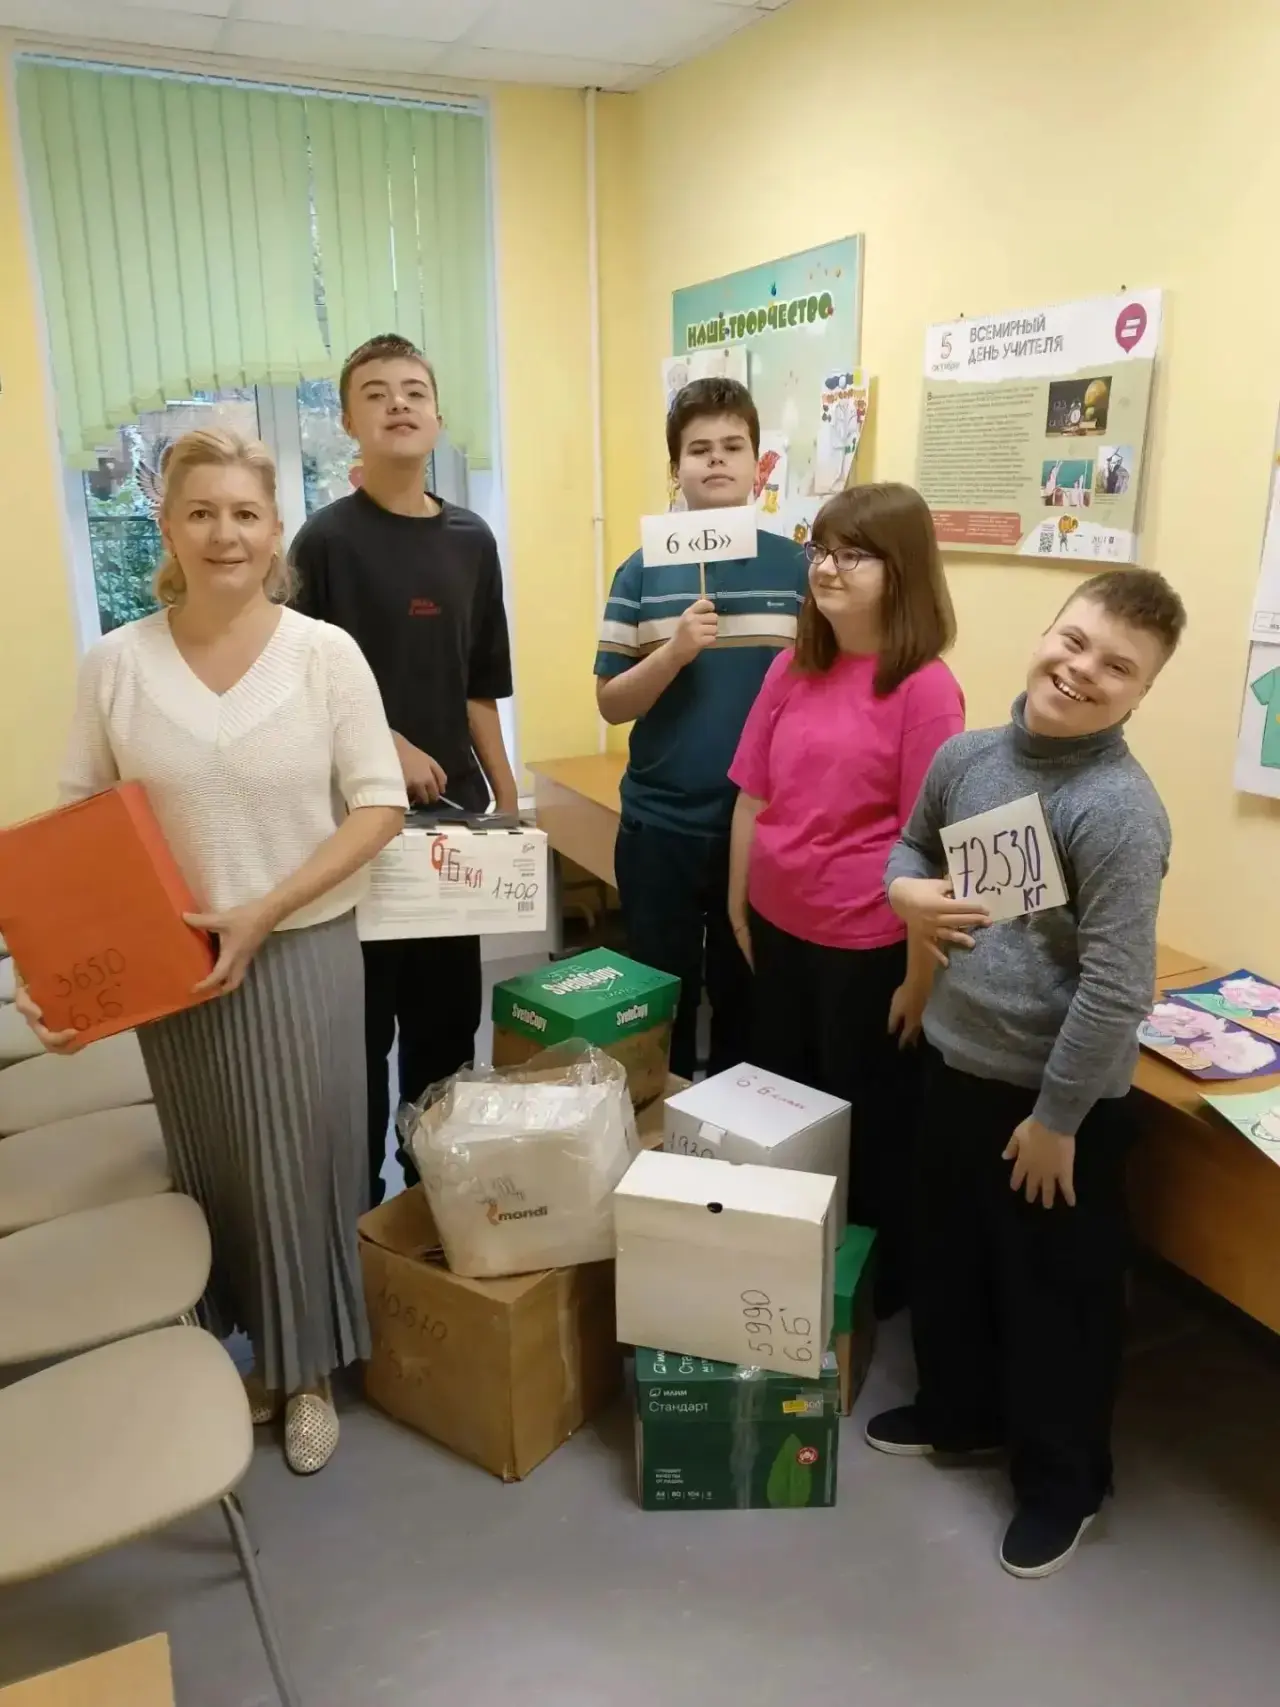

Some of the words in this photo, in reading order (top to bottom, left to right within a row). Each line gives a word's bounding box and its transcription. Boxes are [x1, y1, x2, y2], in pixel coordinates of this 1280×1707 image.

[688, 317, 727, 348] НАШЕ
[729, 292, 833, 338] ТВОРЧЕСТВО
[969, 313, 1046, 343] ВСЕМИРНЫЙ
[940, 332, 953, 360] 5
[967, 346, 999, 366] ДЕНЬ
[1002, 335, 1064, 359] УЧИТЕЛЯ
[666, 532, 680, 554] 6
[688, 528, 732, 552] «Б»
[948, 825, 1041, 898] 72,530
[491, 876, 539, 900] 1700
[54, 948, 126, 998] 3650
[541, 966, 624, 995] SvetoCopy
[512, 1003, 547, 1032] SvetoCopy
[616, 1003, 648, 1026] SvetoCopy
[498, 1205, 548, 1221] mondi
[740, 1289, 773, 1356] 5990
[649, 1400, 709, 1414] Стандарт
